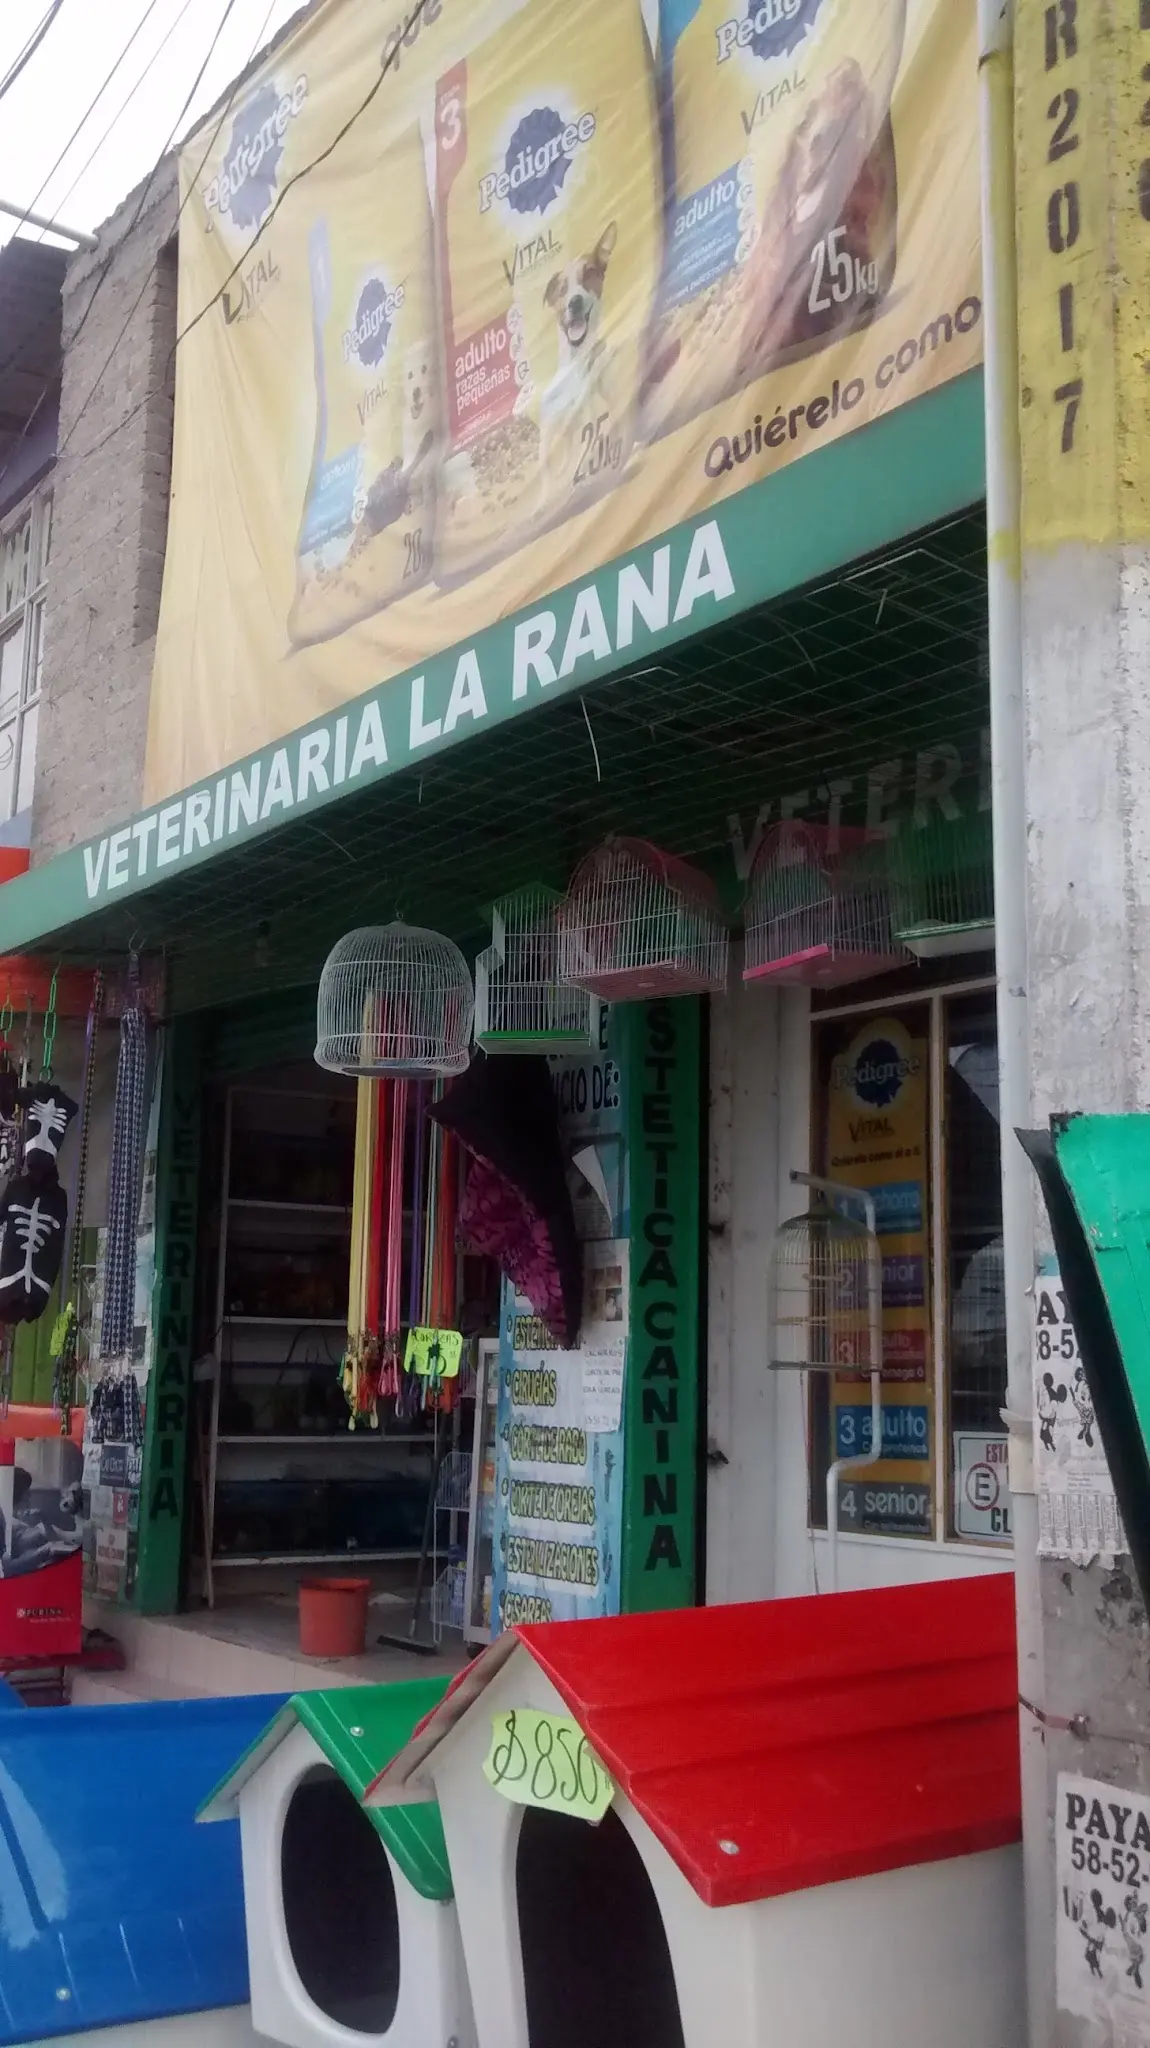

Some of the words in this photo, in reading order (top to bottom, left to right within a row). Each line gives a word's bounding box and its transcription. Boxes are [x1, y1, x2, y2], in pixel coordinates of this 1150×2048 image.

[440, 98, 462, 151] 3
[741, 71, 806, 136] VITAL
[202, 73, 309, 233] Pedigree
[479, 111, 597, 214] Pedigree
[674, 179, 736, 238] adulto
[502, 229, 560, 287] VITAL
[807, 225, 880, 317] 25kg
[341, 283, 407, 364] Pedigree
[455, 328, 507, 378] adulto
[455, 366, 486, 397] razas
[357, 378, 388, 426] VITAL
[456, 364, 511, 416] pequeñas
[703, 378, 864, 479] Quiérelo
[875, 294, 982, 389] como
[572, 411, 623, 486] 25kg
[83, 700, 388, 899] VETERINARIA
[408, 648, 489, 750] LA
[512, 519, 736, 701] RANA
[592, 1061, 620, 1110] DE:
[833, 1056, 922, 1090] Pedigree
[637, 1005, 678, 1288] STETICA
[848, 1116, 896, 1144] VITAL
[857, 1189, 920, 1215] cchorro
[150, 1088, 194, 1521] VETERINARIA
[511, 1361, 557, 1407] CIRUGÍAS
[640, 1301, 682, 1571] CANINA
[839, 1414, 856, 1445] 3
[840, 1490, 858, 1518] 4
[864, 1486, 928, 1516] senior
[974, 1473, 991, 1501] E
[493, 1709, 598, 1805] $850
